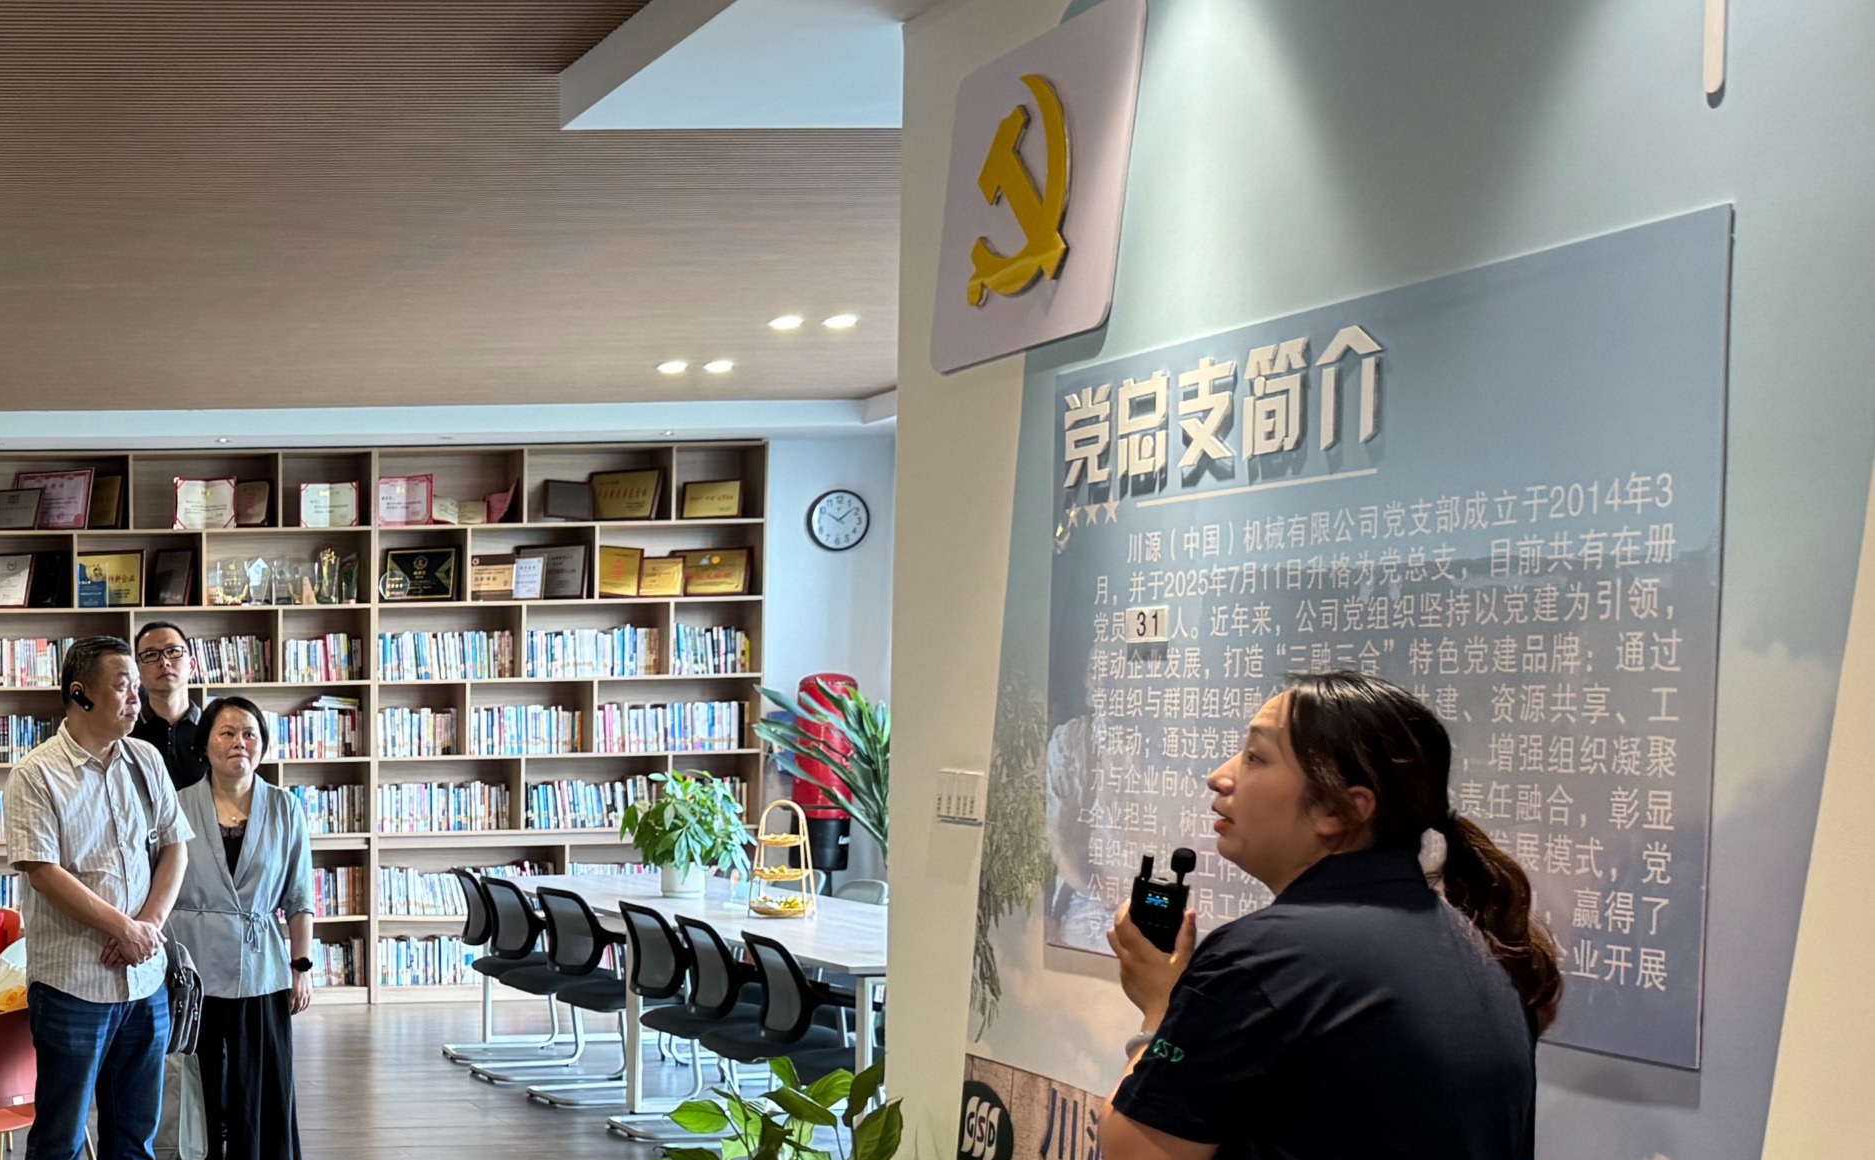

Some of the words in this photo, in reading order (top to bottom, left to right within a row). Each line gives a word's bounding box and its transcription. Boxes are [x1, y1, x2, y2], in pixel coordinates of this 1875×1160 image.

[1062, 325, 1385, 489] 党总支简介
[1093, 611, 1126, 643] 党员
[1136, 610, 1160, 638] 31
[1090, 725, 1248, 759] 作联动；通过党建
[1153, 1038, 1186, 1062] GSD
